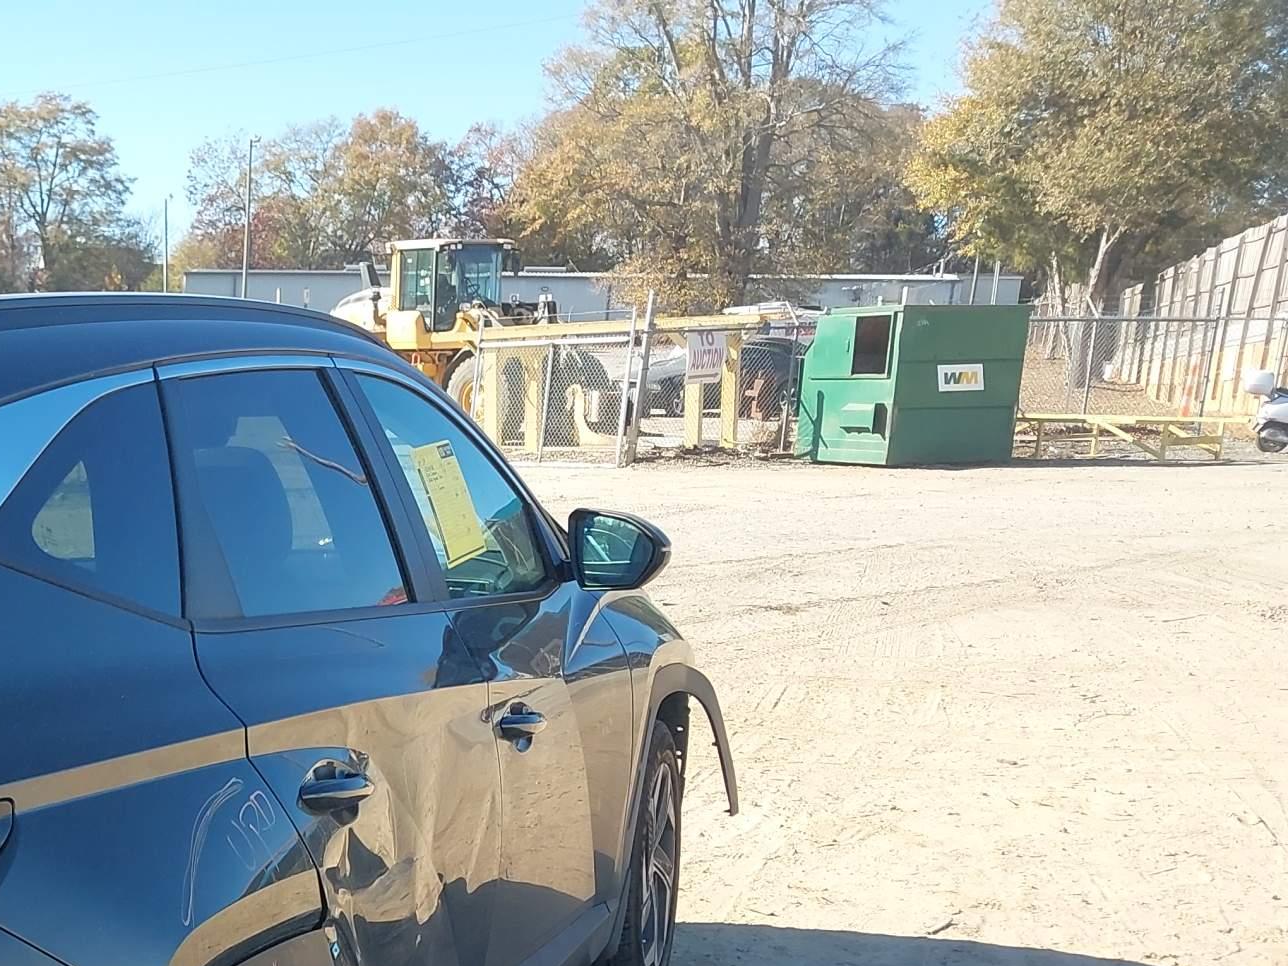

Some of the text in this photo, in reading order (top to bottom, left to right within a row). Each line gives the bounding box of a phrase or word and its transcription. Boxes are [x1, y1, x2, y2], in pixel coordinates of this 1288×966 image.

[697, 331, 715, 347] TO
[689, 347, 724, 371] AUCTION
[944, 371, 979, 385] WM
